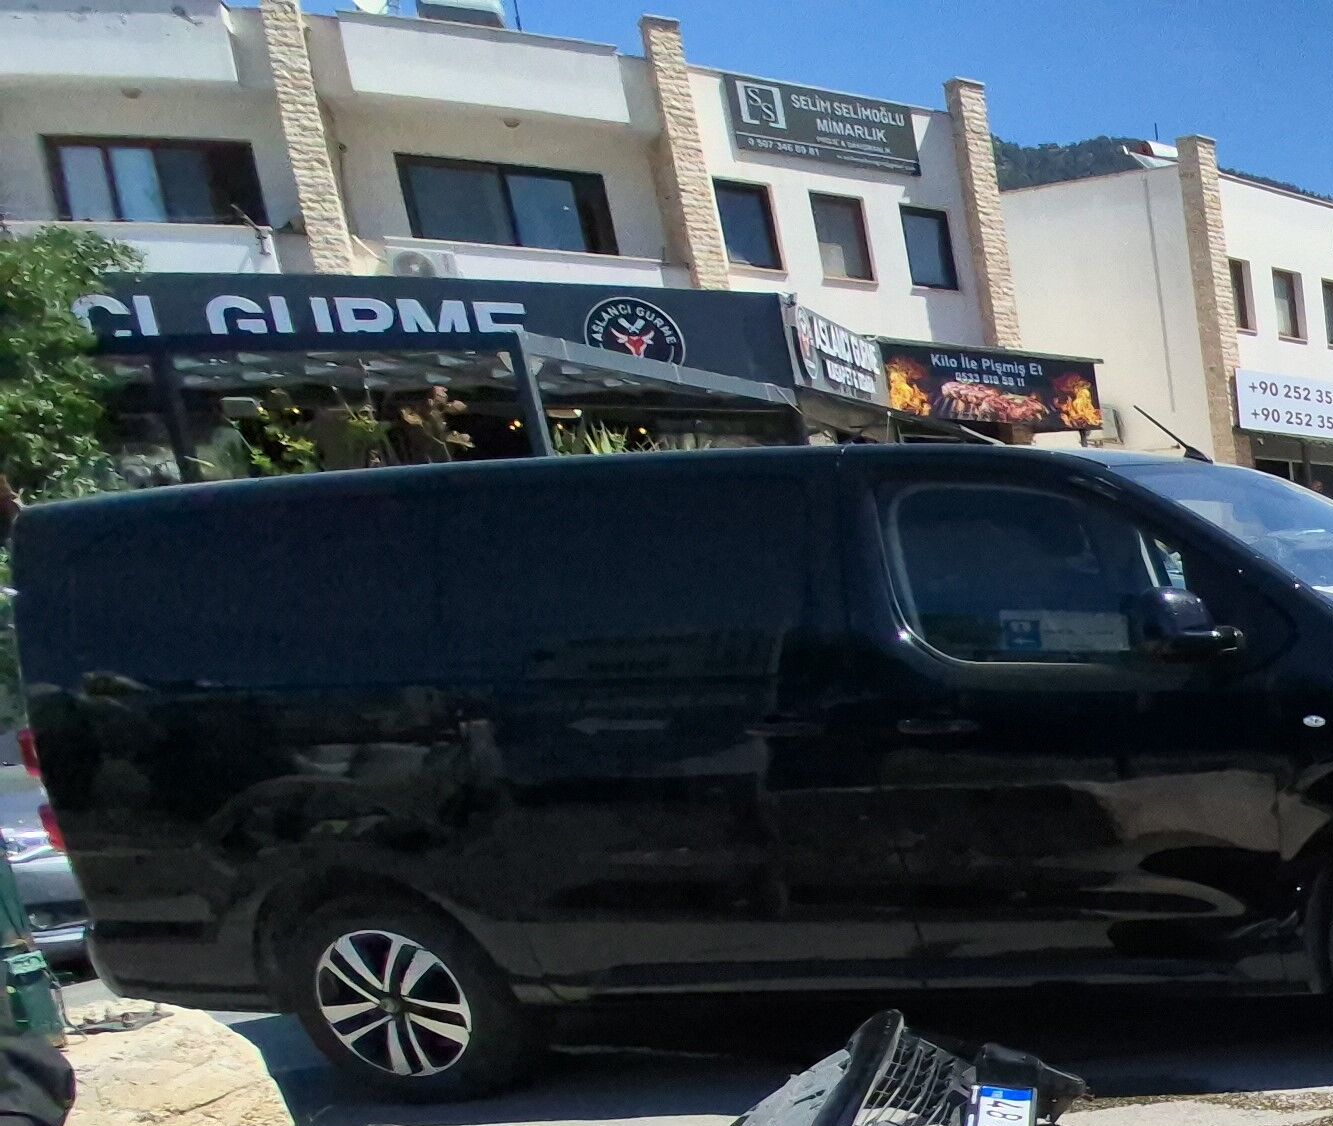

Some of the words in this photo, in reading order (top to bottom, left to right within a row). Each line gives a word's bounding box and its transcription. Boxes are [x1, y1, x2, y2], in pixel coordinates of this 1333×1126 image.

[790, 94, 831, 113] SELİM
[816, 117, 888, 143] MİMARLIK
[591, 304, 632, 342] ASLANCI
[635, 306, 677, 345] GURME
[930, 353, 958, 368] Kilo
[1029, 363, 1043, 376] Et
[1249, 381, 1278, 397] +90
[1283, 384, 1311, 401] 252
[1251, 408, 1280, 423] +90
[1285, 411, 1312, 427] 252
[986, 1100, 1023, 1121] 48
